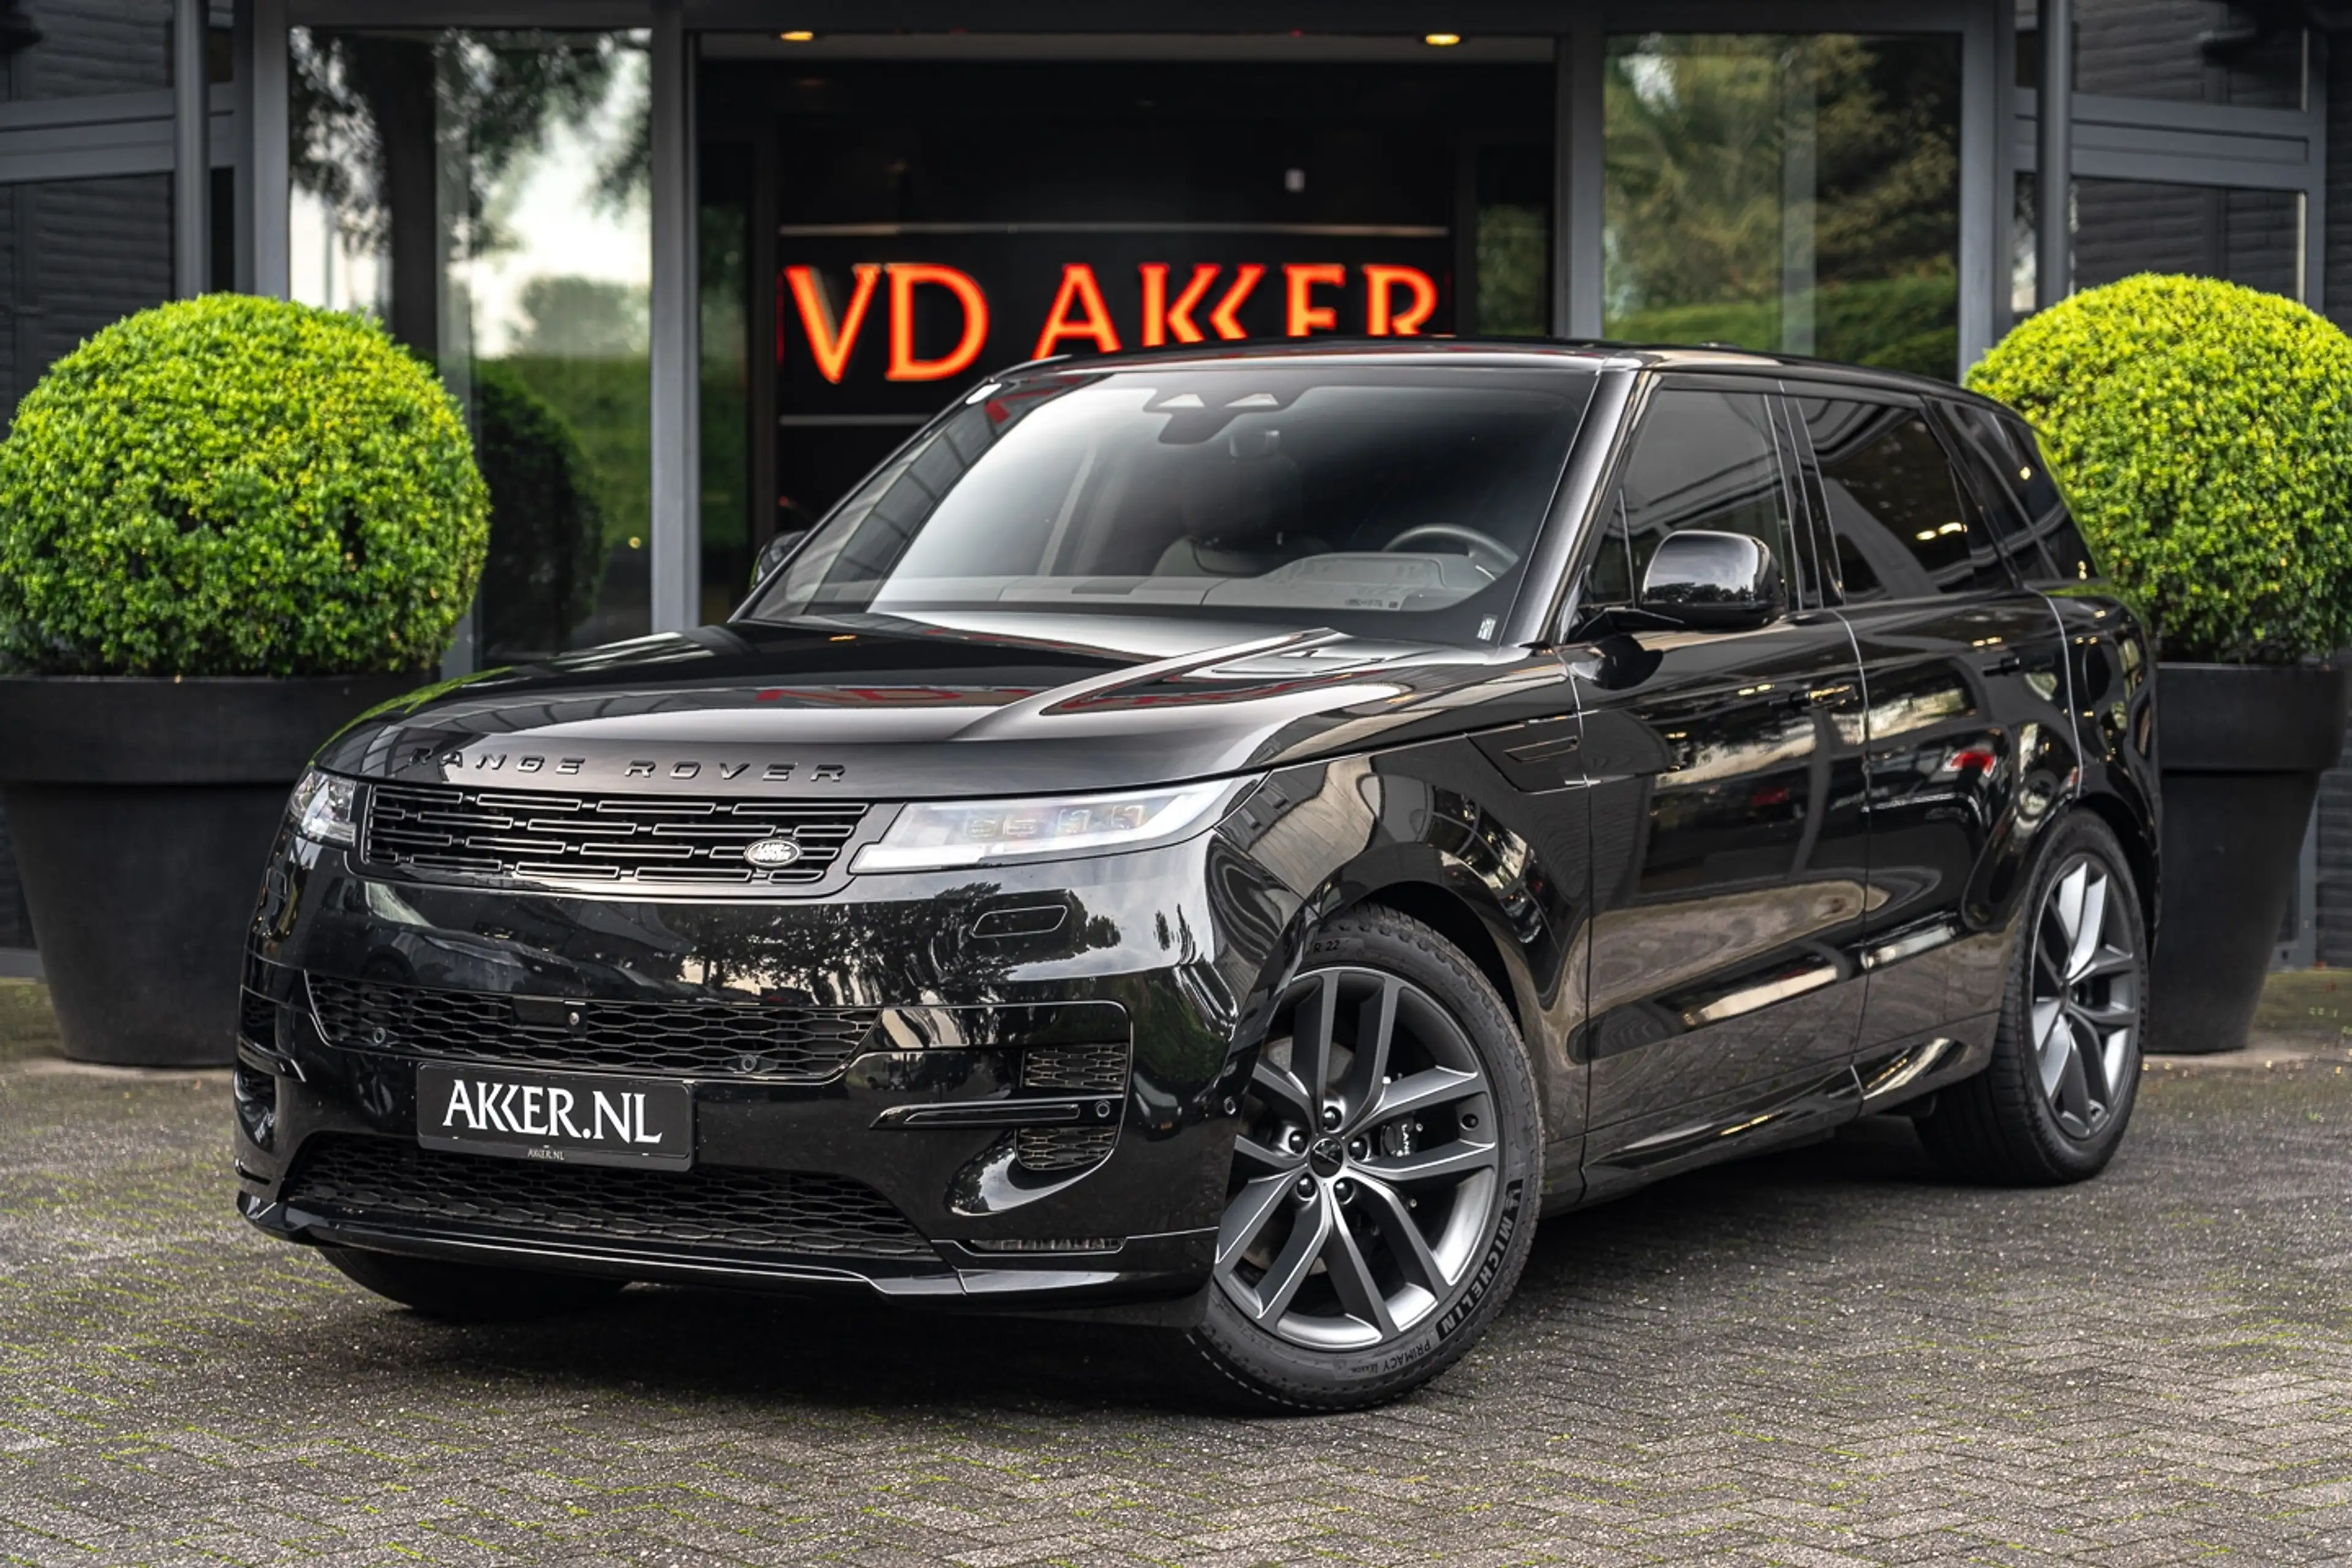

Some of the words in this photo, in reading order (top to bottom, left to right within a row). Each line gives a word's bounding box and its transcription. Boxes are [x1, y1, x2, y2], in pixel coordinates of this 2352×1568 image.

[783, 262, 990, 383] VD
[1031, 262, 1439, 360] AKKER
[408, 748, 586, 776] RANGE
[624, 759, 846, 782] ROVER
[442, 1079, 663, 1144] AKKER.NL
[1441, 1216, 1514, 1334] MICHELIN
[1382, 1338, 1431, 1372] PRIMACY
